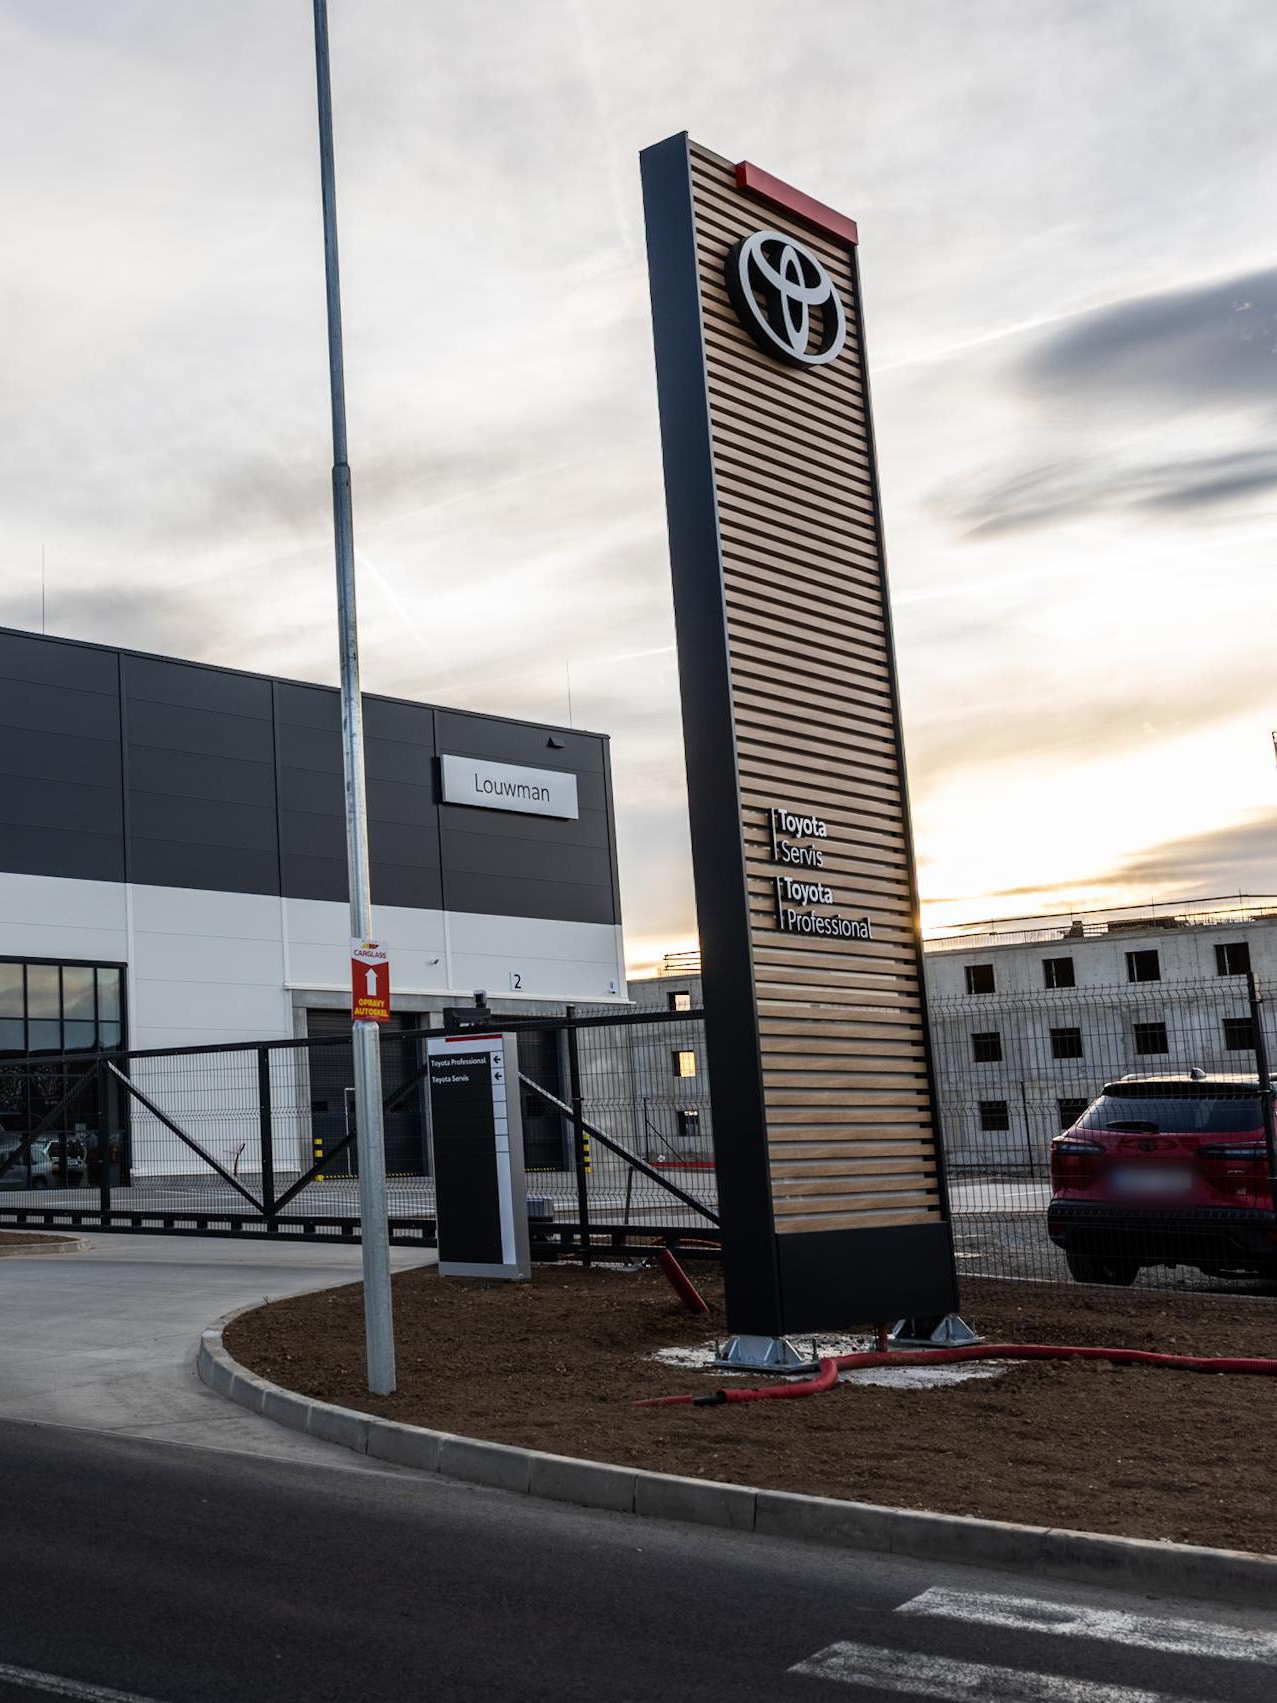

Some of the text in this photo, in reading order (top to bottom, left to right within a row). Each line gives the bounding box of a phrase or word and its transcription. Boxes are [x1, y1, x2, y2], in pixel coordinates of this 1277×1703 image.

[474, 773, 550, 802] Louwman
[778, 808, 828, 838] Toyota
[781, 840, 824, 868] Servis
[784, 877, 834, 906] Toyota
[787, 909, 874, 940] Professional
[353, 949, 387, 959] CARGLASS
[514, 973, 522, 989] 2
[358, 998, 385, 1008] OPRAVY
[431, 1057, 487, 1069] Toyota Professional
[432, 1074, 470, 1085] Toyota Servis
